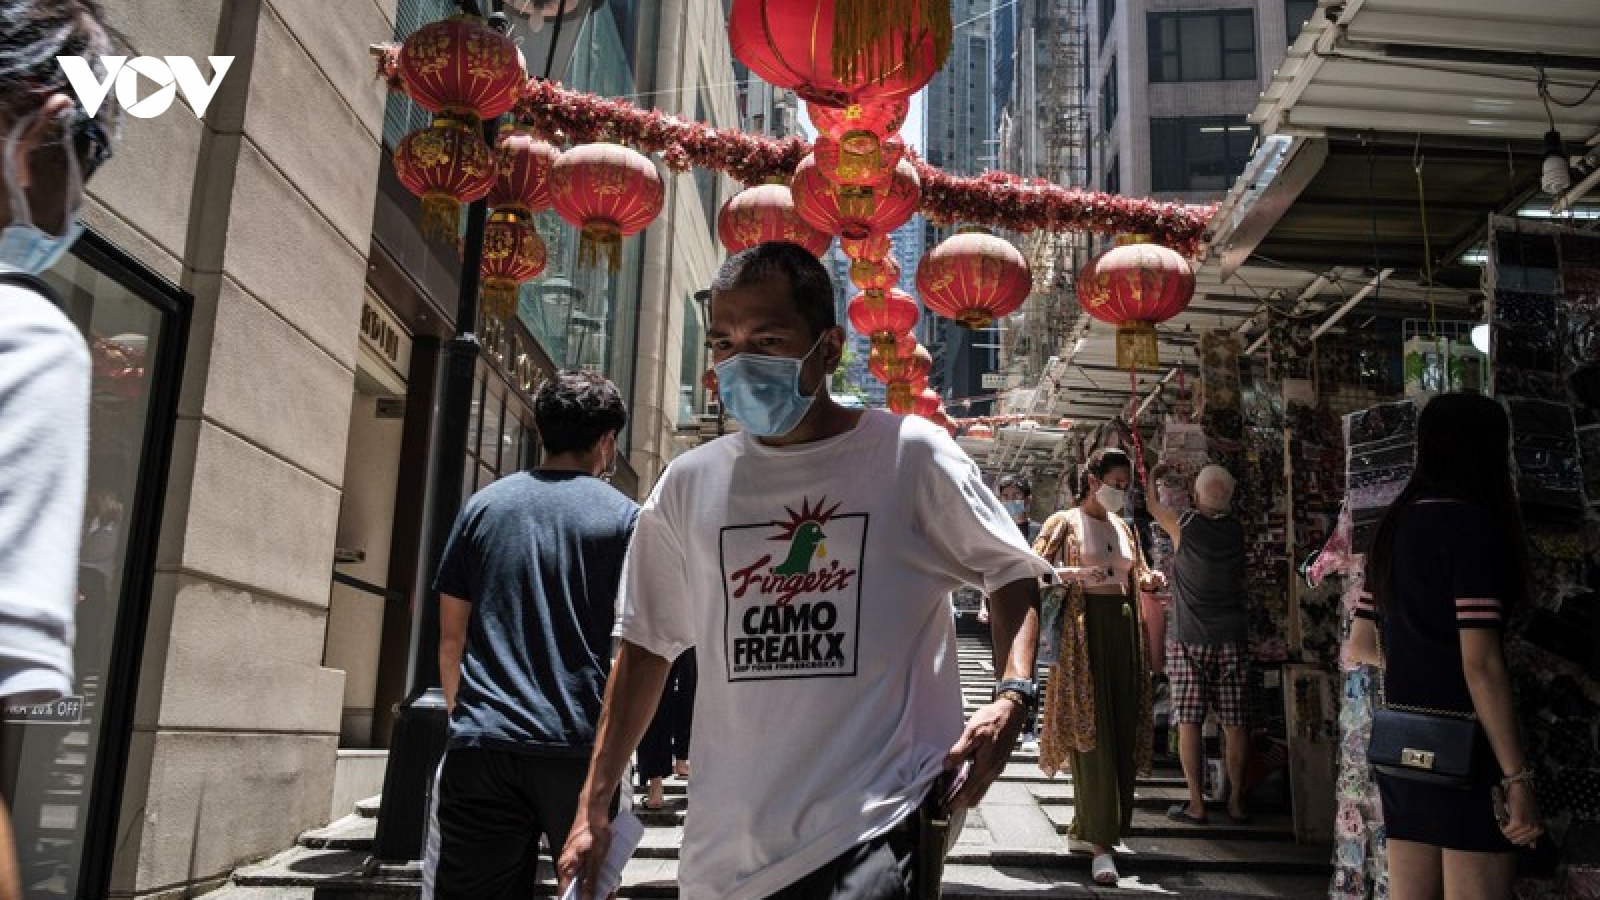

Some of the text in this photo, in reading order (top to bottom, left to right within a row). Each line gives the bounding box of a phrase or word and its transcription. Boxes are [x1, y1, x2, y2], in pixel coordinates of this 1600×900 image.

[731, 553, 857, 607] Finger'x
[742, 602, 837, 634] CAMO
[733, 632, 845, 665] FREAKX
[57, 701, 79, 717] OFF
